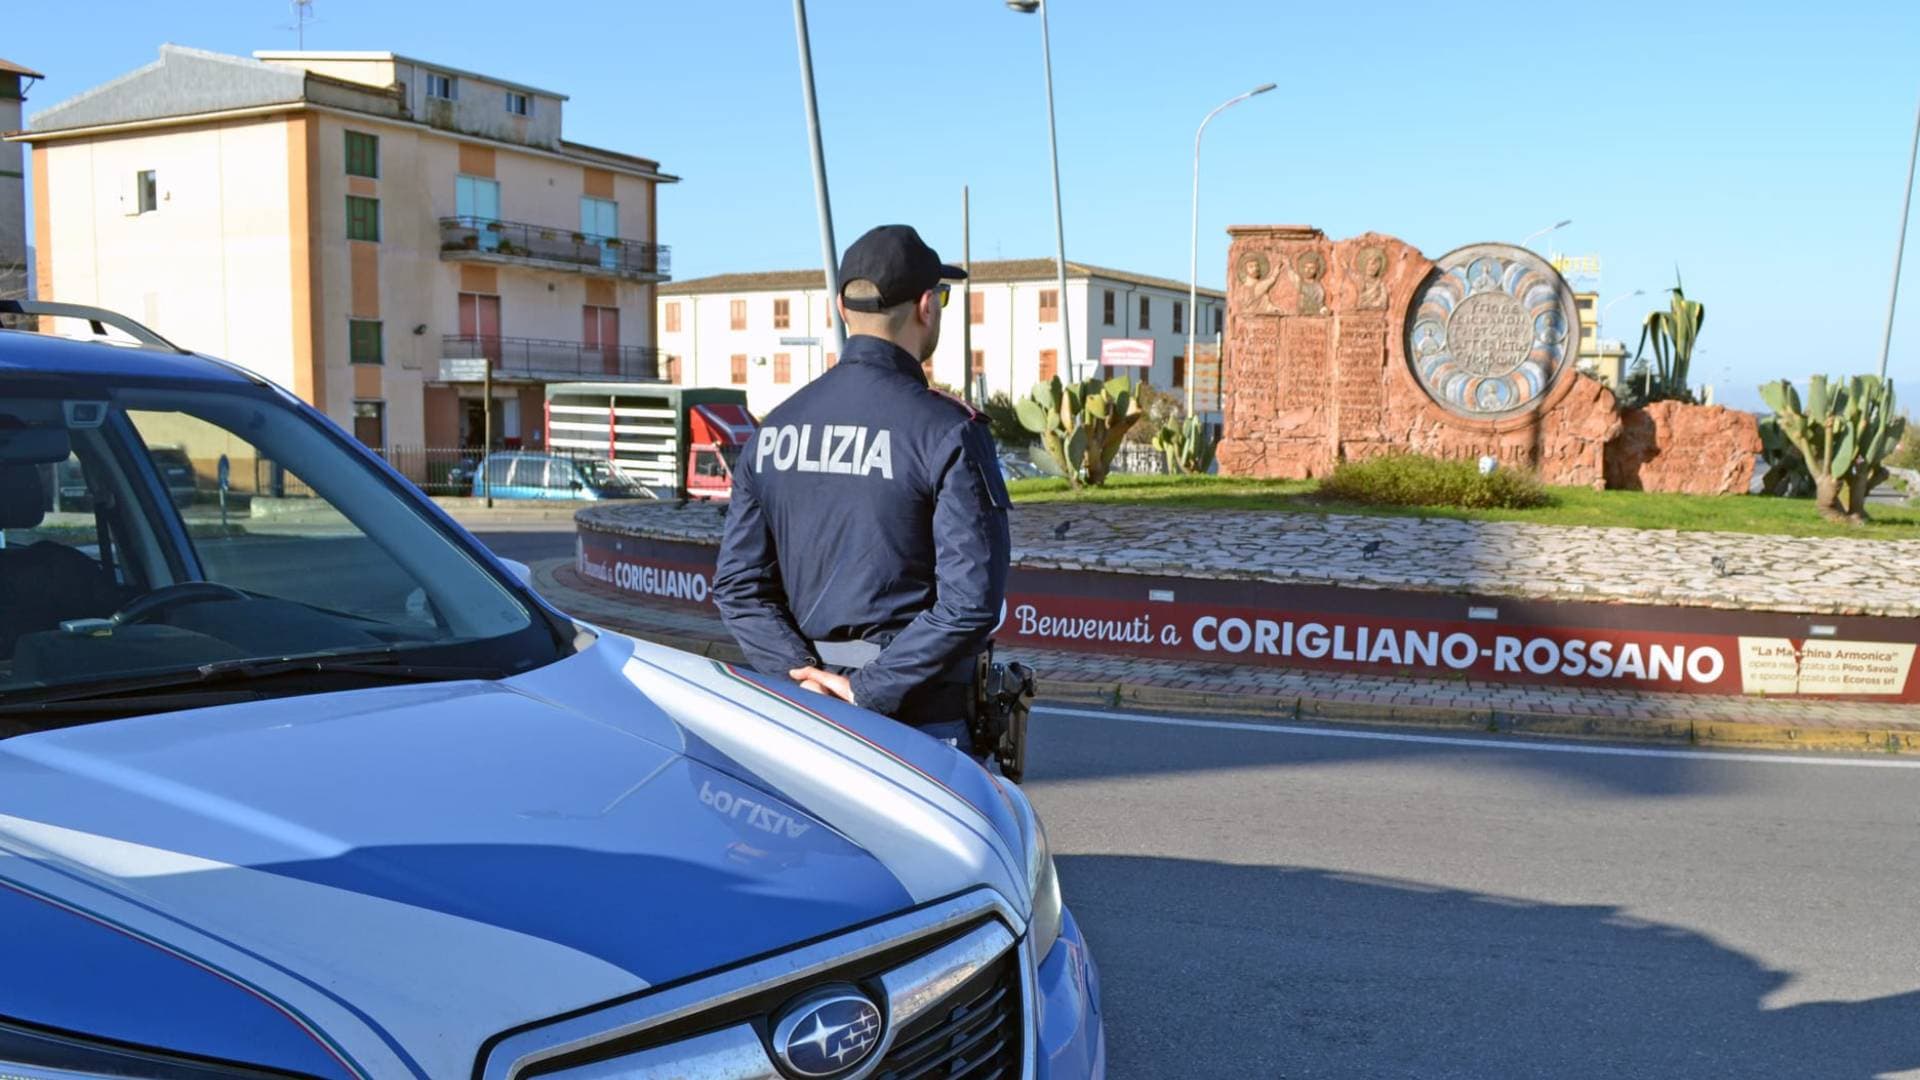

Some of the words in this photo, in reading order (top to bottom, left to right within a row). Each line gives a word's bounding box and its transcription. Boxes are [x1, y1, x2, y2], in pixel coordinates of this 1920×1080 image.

[755, 424, 893, 479] POLIZIA
[614, 561, 714, 602] CORIGLIANO-
[1014, 604, 1155, 644] Benvenuti
[1160, 623, 1182, 646] a
[1192, 615, 1725, 684] CORIGLIANO-ROSSANO
[1843, 663, 1864, 672] Pino
